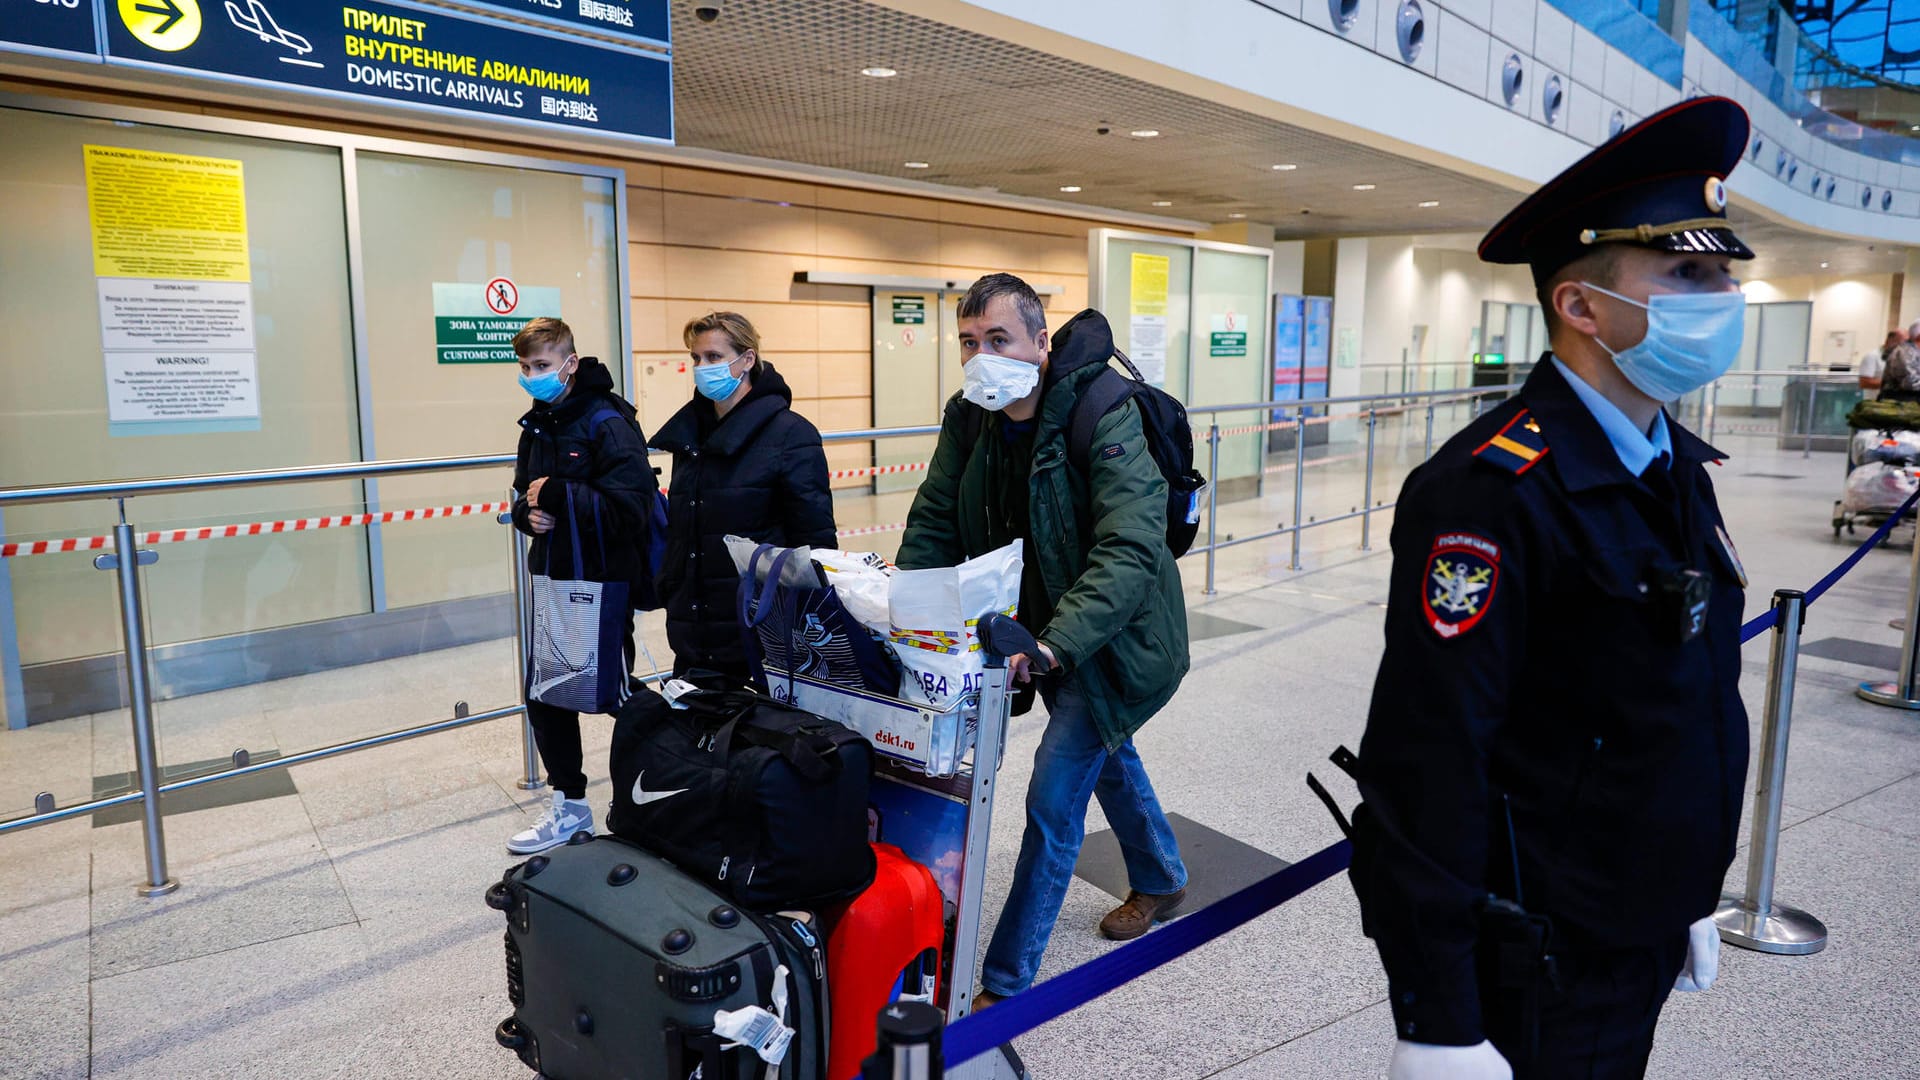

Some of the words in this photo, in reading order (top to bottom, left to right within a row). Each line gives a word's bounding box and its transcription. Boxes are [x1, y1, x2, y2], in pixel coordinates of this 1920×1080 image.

[343, 7, 426, 41] ПРИЛЕТ
[579, 0, 634, 27] 国际到达
[344, 35, 478, 77] ВНУТРЕННИЕ
[481, 60, 590, 96] АВИАЛИНИИ
[347, 63, 443, 96] DOMESTIC
[446, 80, 524, 108] ARRIVALS
[540, 96, 599, 122] 国内到达
[449, 320, 476, 330] ЗОНА
[478, 321, 528, 331] ТАМОЖЕН
[476, 332, 517, 341] КОНТРО
[155, 356, 209, 365] WARNING!
[443, 350, 489, 360] CUSTOMS
[490, 350, 519, 360] CONT
[1438, 535, 1498, 557] ПОЛИЦИЯ
[875, 730, 915, 751] dsk1.ru
